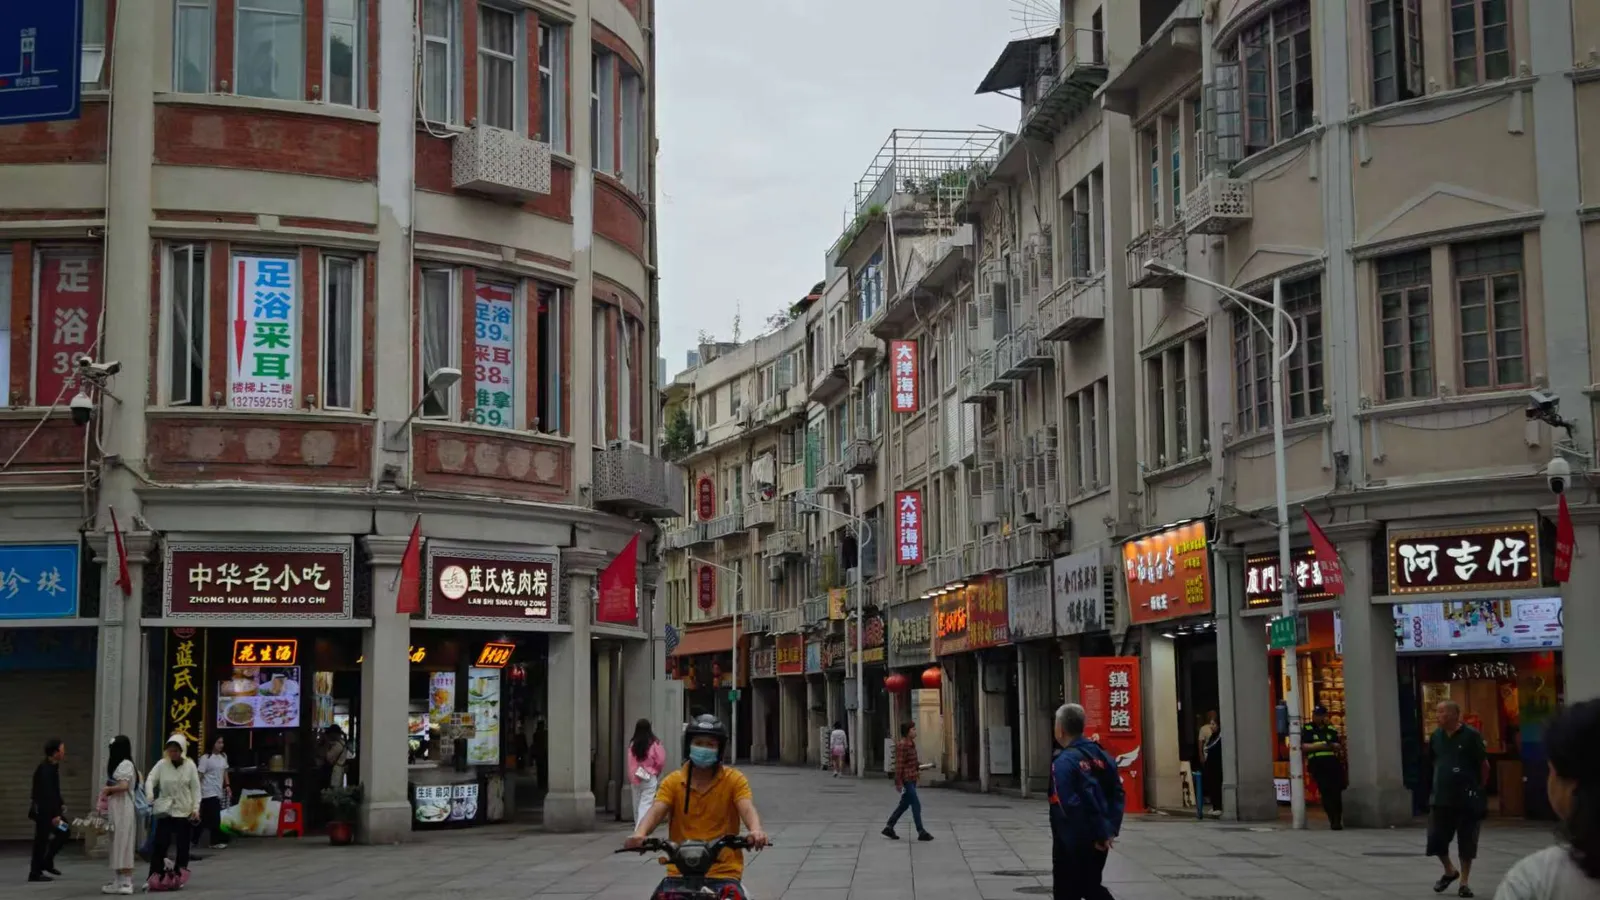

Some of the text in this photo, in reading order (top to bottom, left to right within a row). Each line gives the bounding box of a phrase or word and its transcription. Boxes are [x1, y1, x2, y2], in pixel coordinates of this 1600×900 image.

[53, 259, 90, 346] 足浴
[475, 302, 511, 326] 足浴
[251, 260, 292, 380] 足浴采耳
[475, 344, 511, 367] 采耳
[232, 381, 293, 395] 楼梯上二楼
[896, 343, 914, 409] 大洋海鲜
[231, 396, 293, 409] 13275925513
[900, 495, 919, 561] 大洋海鲜
[1398, 536, 1529, 584] 阿吉仔
[188, 562, 331, 592] 中华名小吃
[467, 565, 548, 598] 蓝氏烧肉粽
[189, 596, 327, 604] ZHONG HUA MING XIAO CHI
[238, 644, 292, 662] 花生汤
[1108, 671, 1131, 727] 镇邦路
